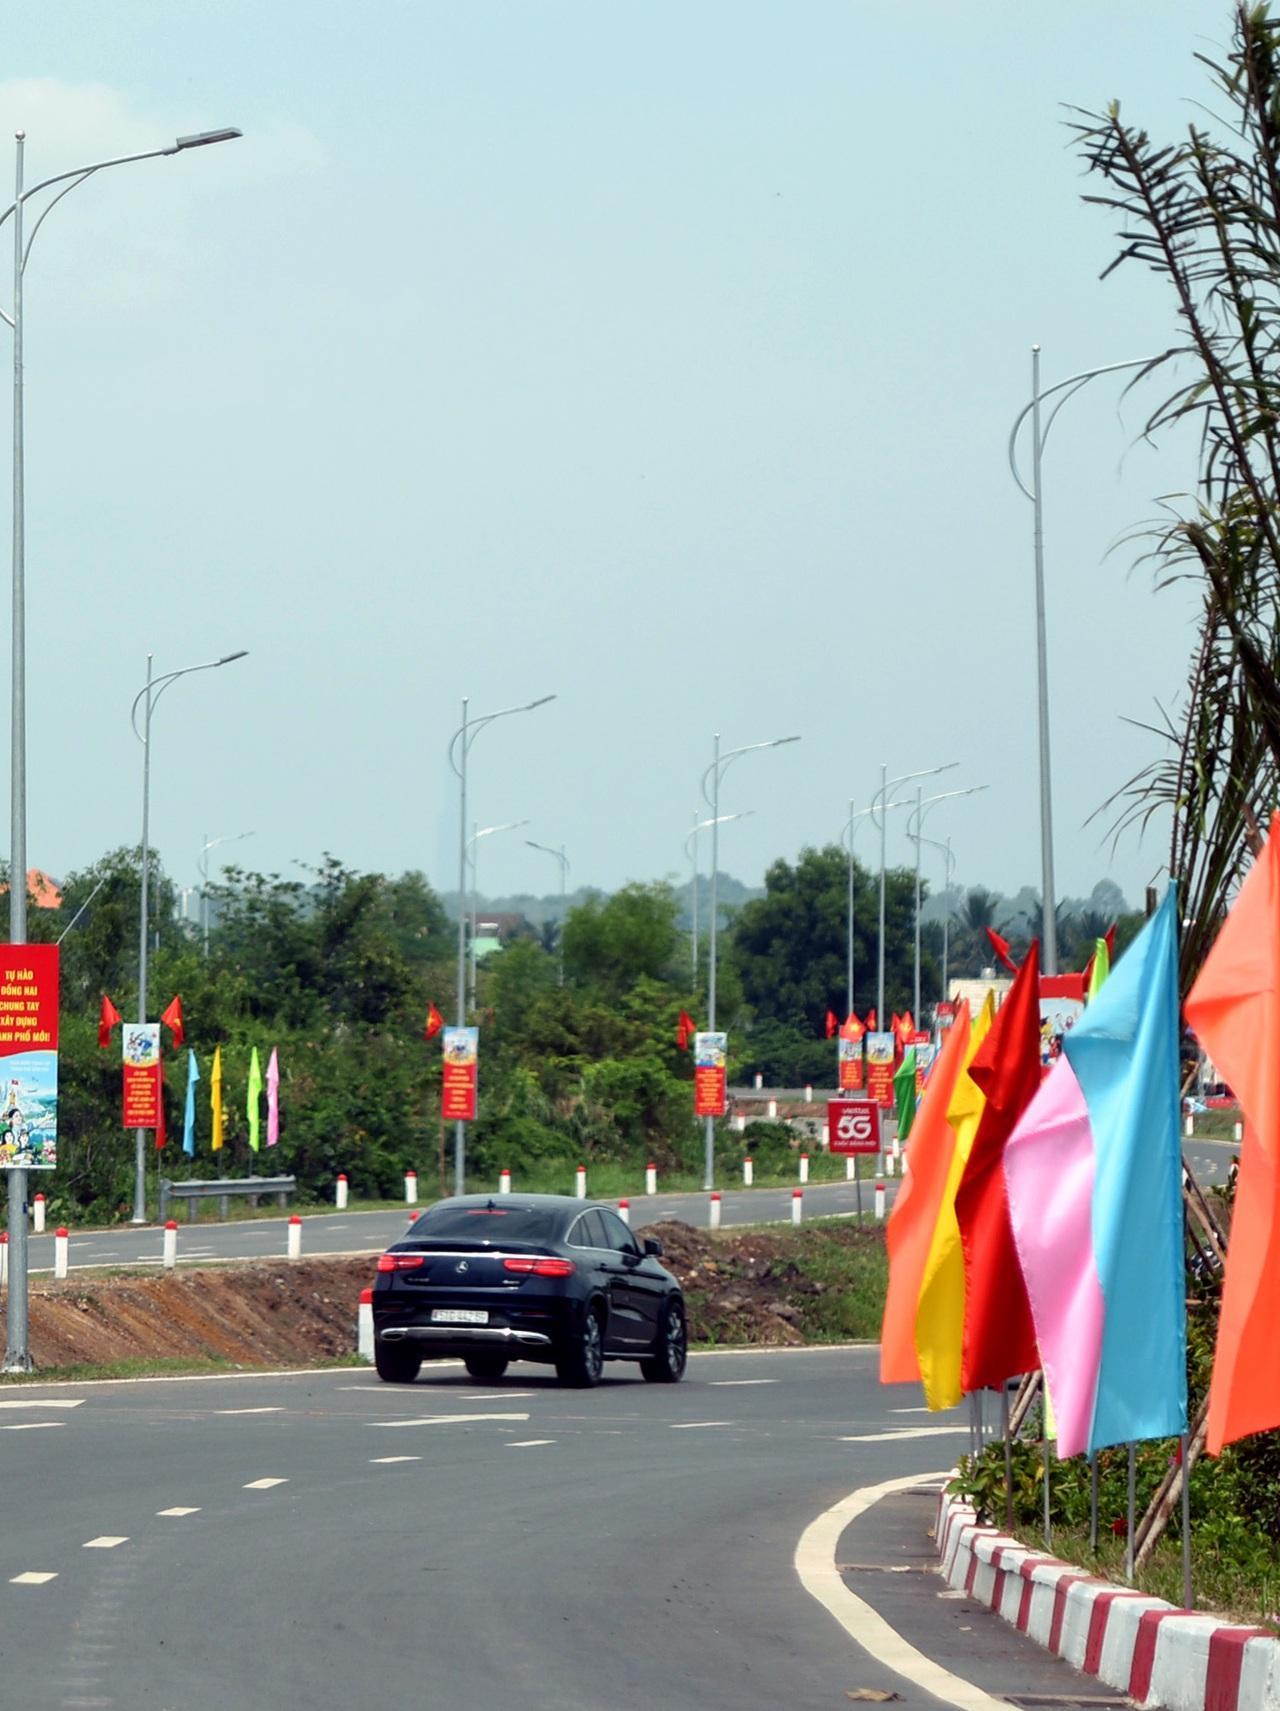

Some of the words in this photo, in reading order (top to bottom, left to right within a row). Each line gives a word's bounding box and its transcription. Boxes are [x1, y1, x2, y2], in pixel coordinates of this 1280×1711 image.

[16, 968, 34, 981] HÀO
[23, 986, 38, 996] NAI
[26, 1001, 40, 1011] TAY
[14, 1029, 31, 1042] PHỐ
[838, 1116, 871, 1139] 5G
